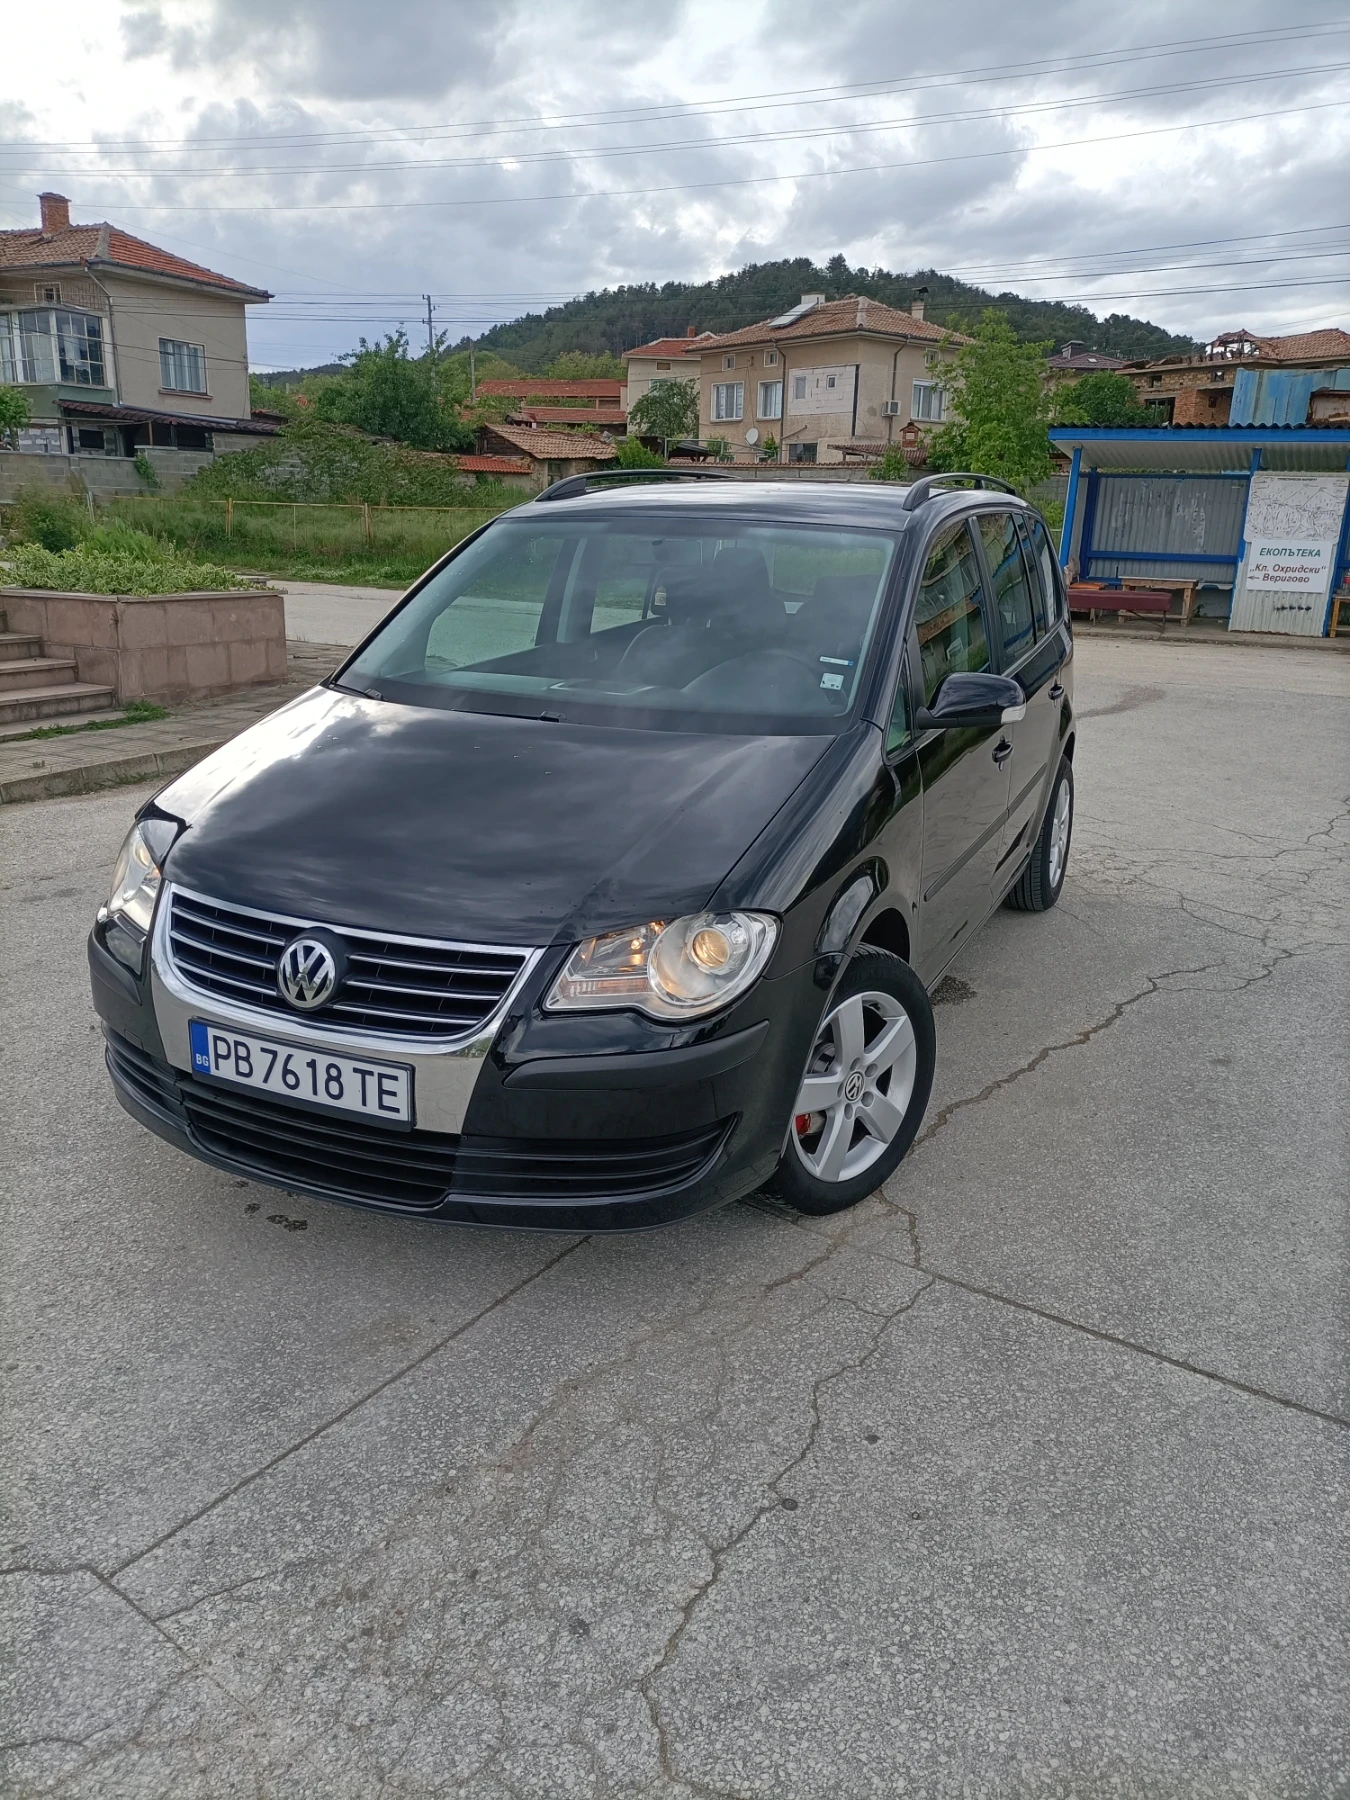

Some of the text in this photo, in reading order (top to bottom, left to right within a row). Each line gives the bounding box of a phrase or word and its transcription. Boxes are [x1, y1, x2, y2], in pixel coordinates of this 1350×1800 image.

[1259, 547, 1321, 557] ЕКОПЪТЕКА
[1262, 573, 1310, 583] Веригово
[195, 1053, 209, 1067] BG
